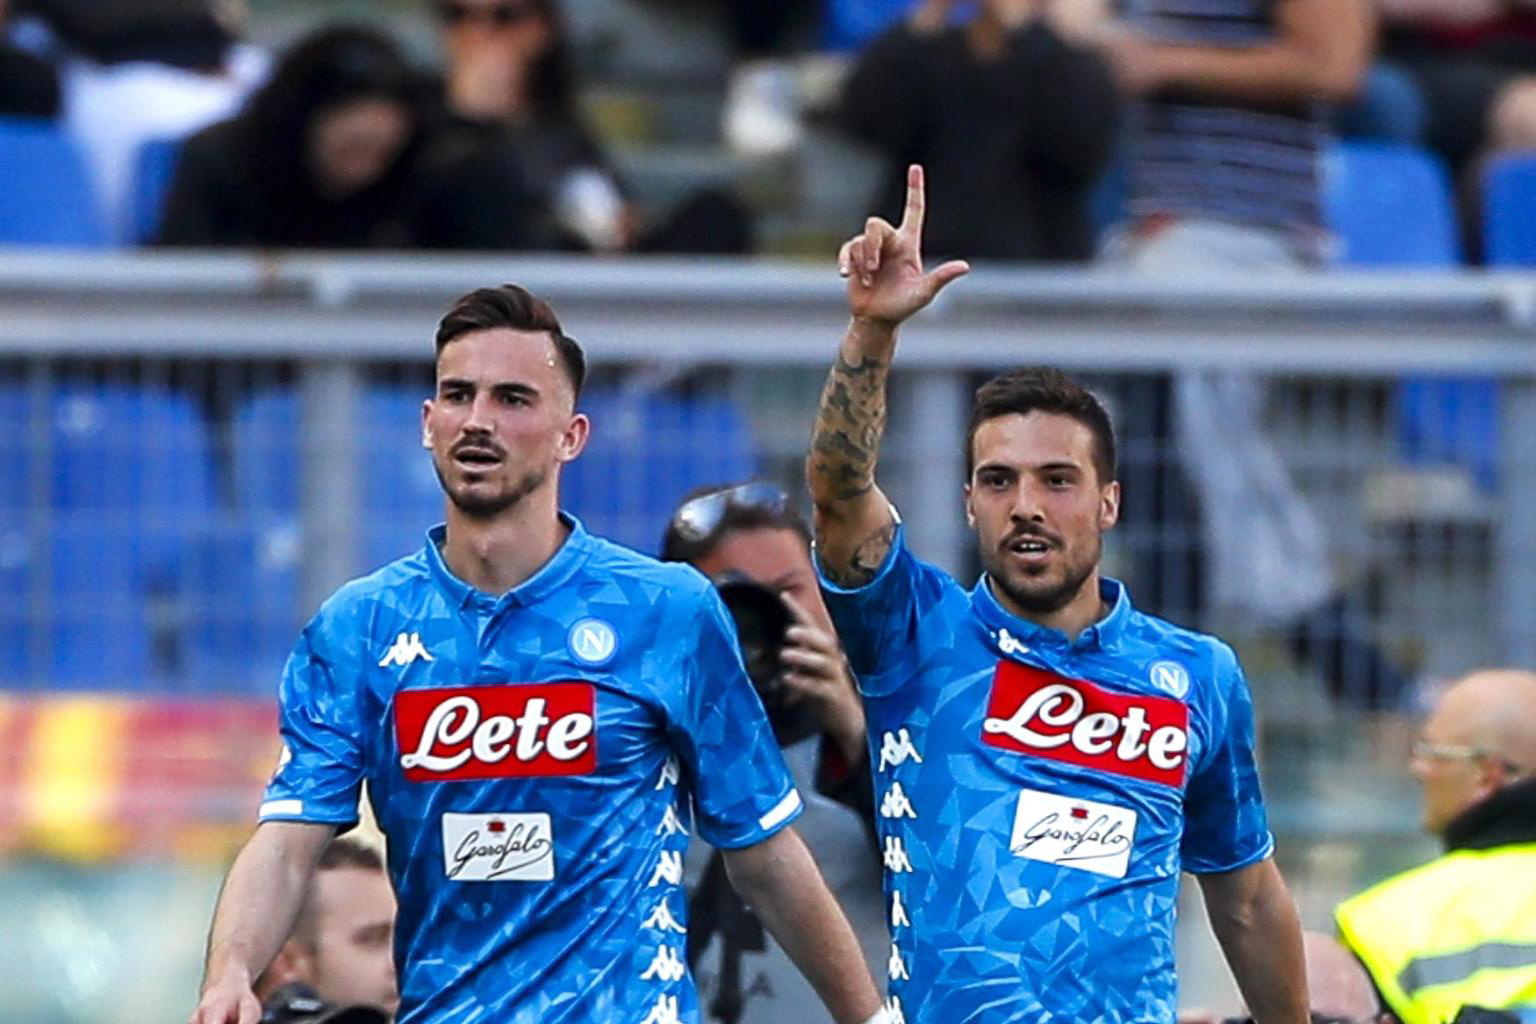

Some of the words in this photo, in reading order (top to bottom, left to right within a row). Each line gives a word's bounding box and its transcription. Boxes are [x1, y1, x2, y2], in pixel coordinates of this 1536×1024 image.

[400, 695, 593, 773] Lete
[983, 683, 1188, 770] Lete
[446, 822, 553, 880] Garofalo
[1010, 812, 1131, 864] Garofalo
